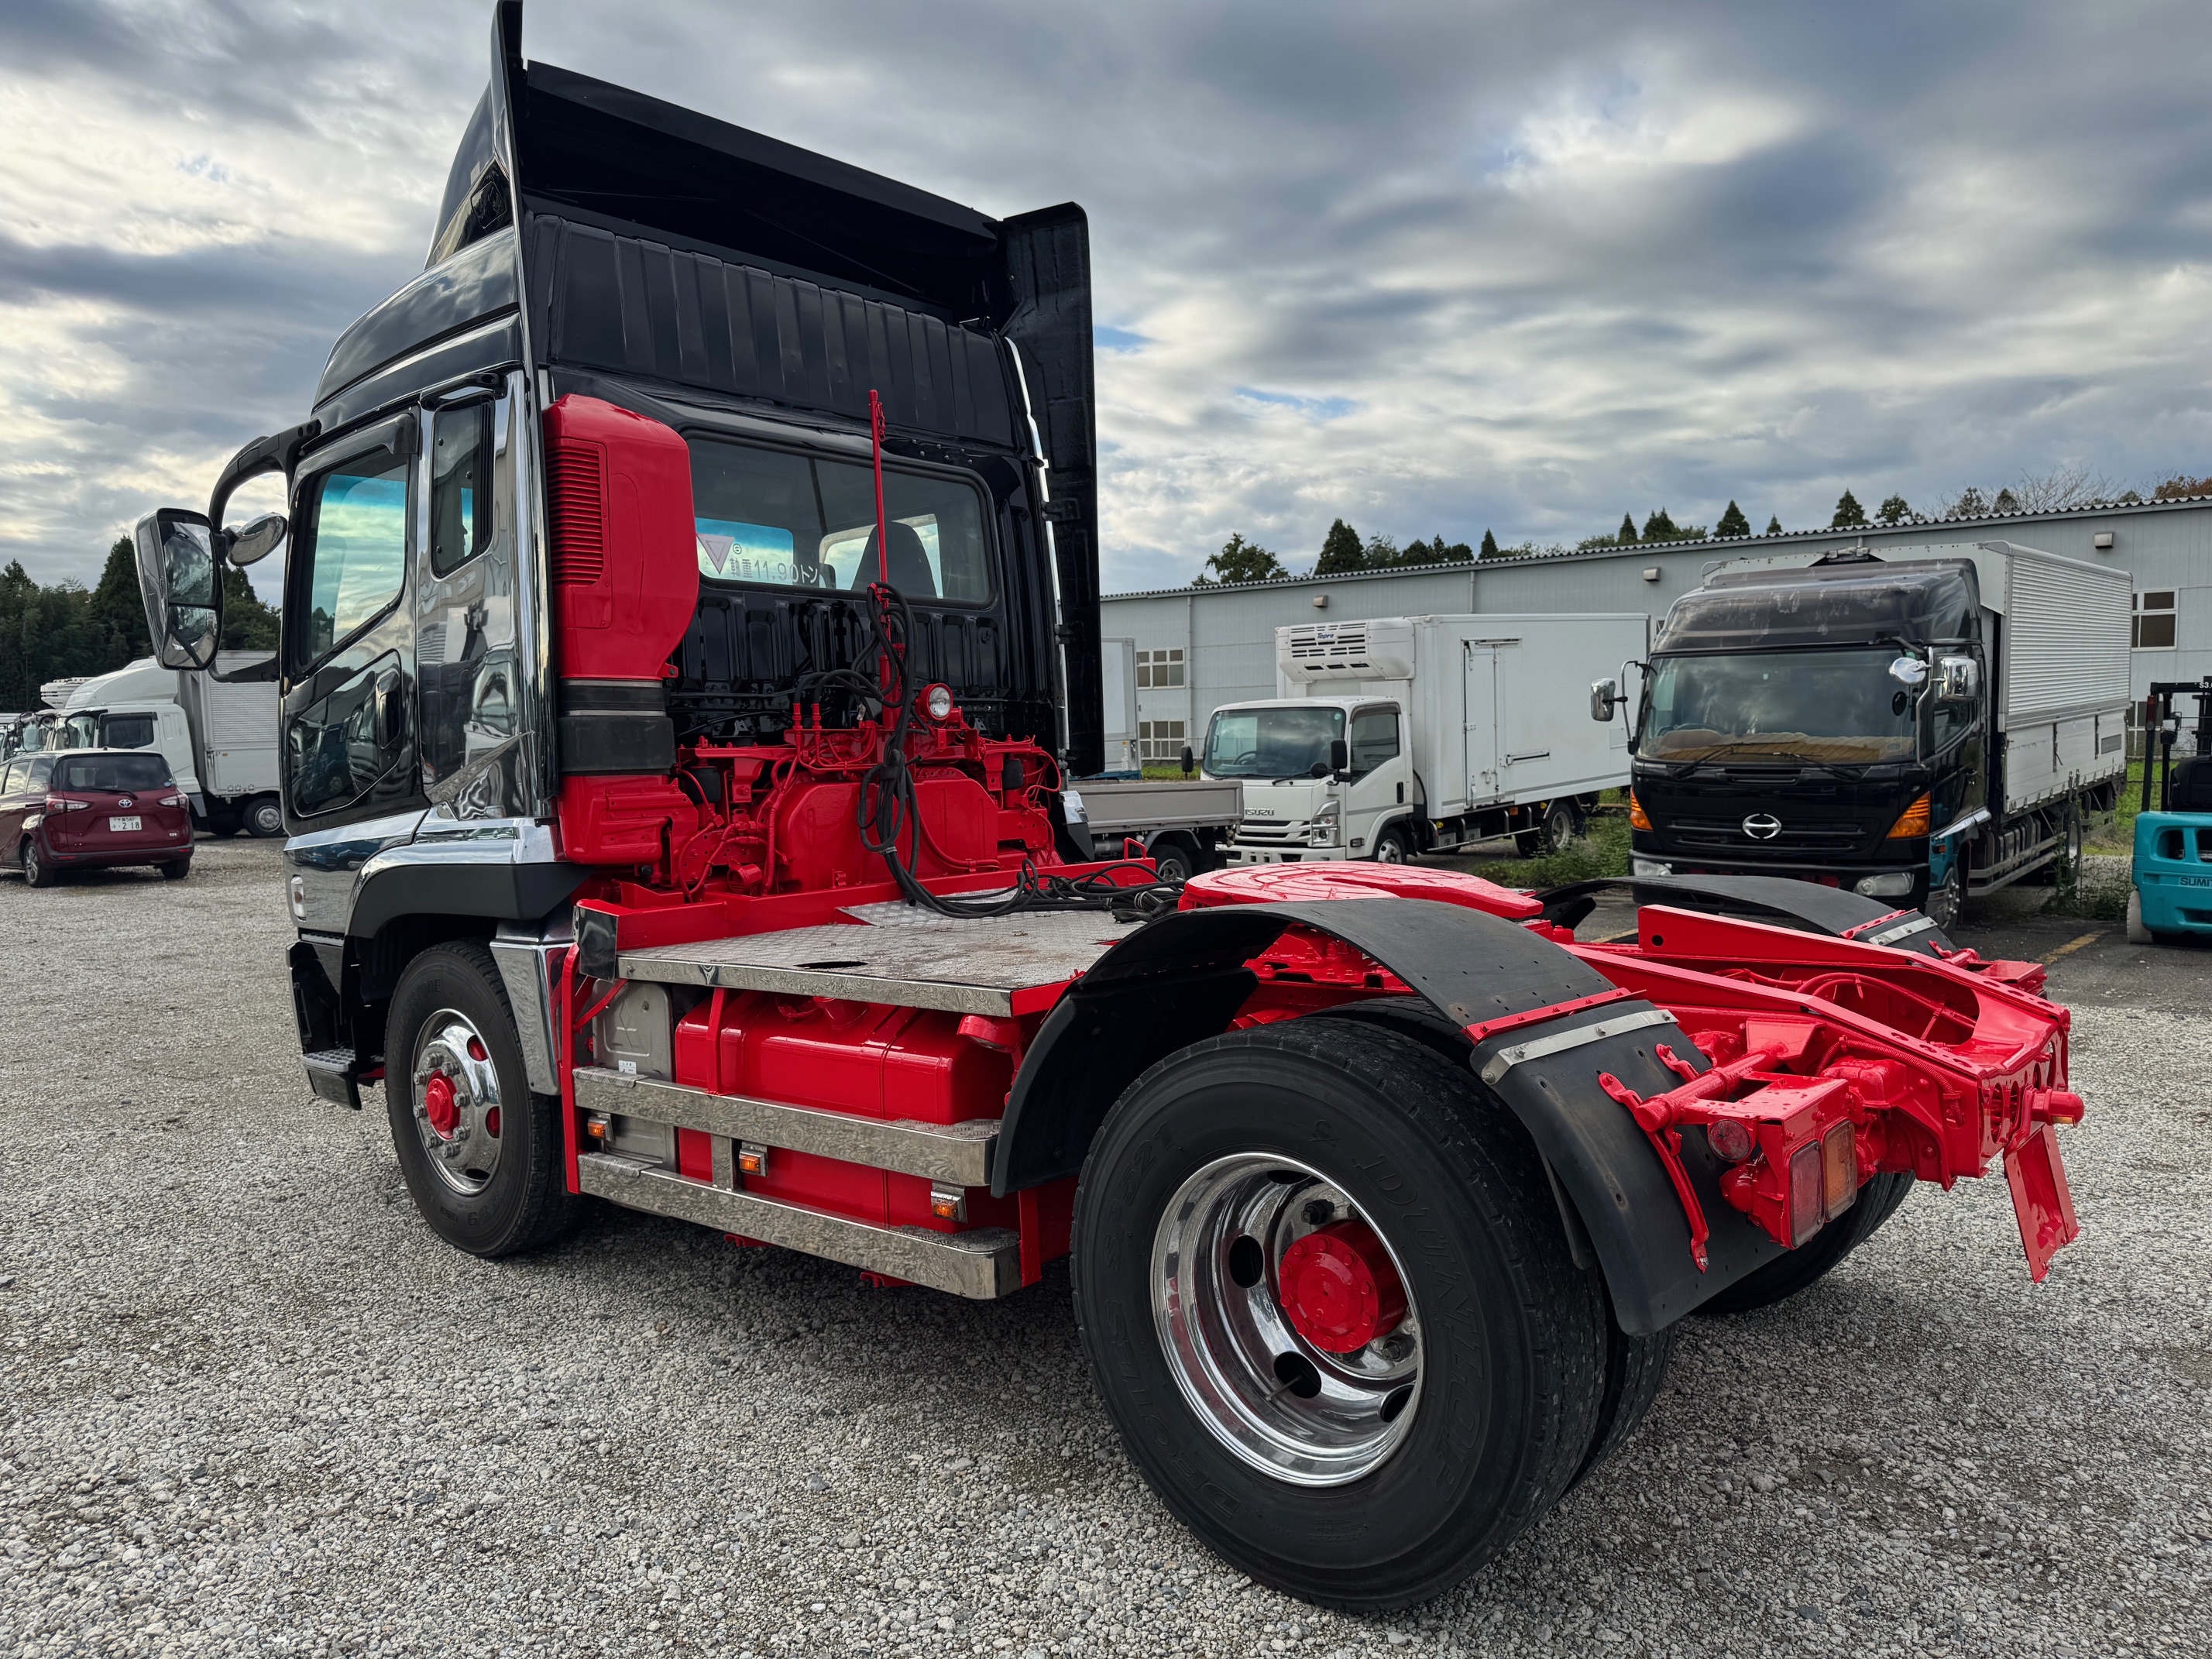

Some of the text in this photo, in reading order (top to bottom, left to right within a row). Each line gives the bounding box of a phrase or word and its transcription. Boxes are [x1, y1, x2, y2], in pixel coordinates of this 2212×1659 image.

[1245, 808, 1275, 816] ISUZU
[2180, 877, 2212, 887] SUMI
[1354, 1154, 1484, 1503] DUNLOP
